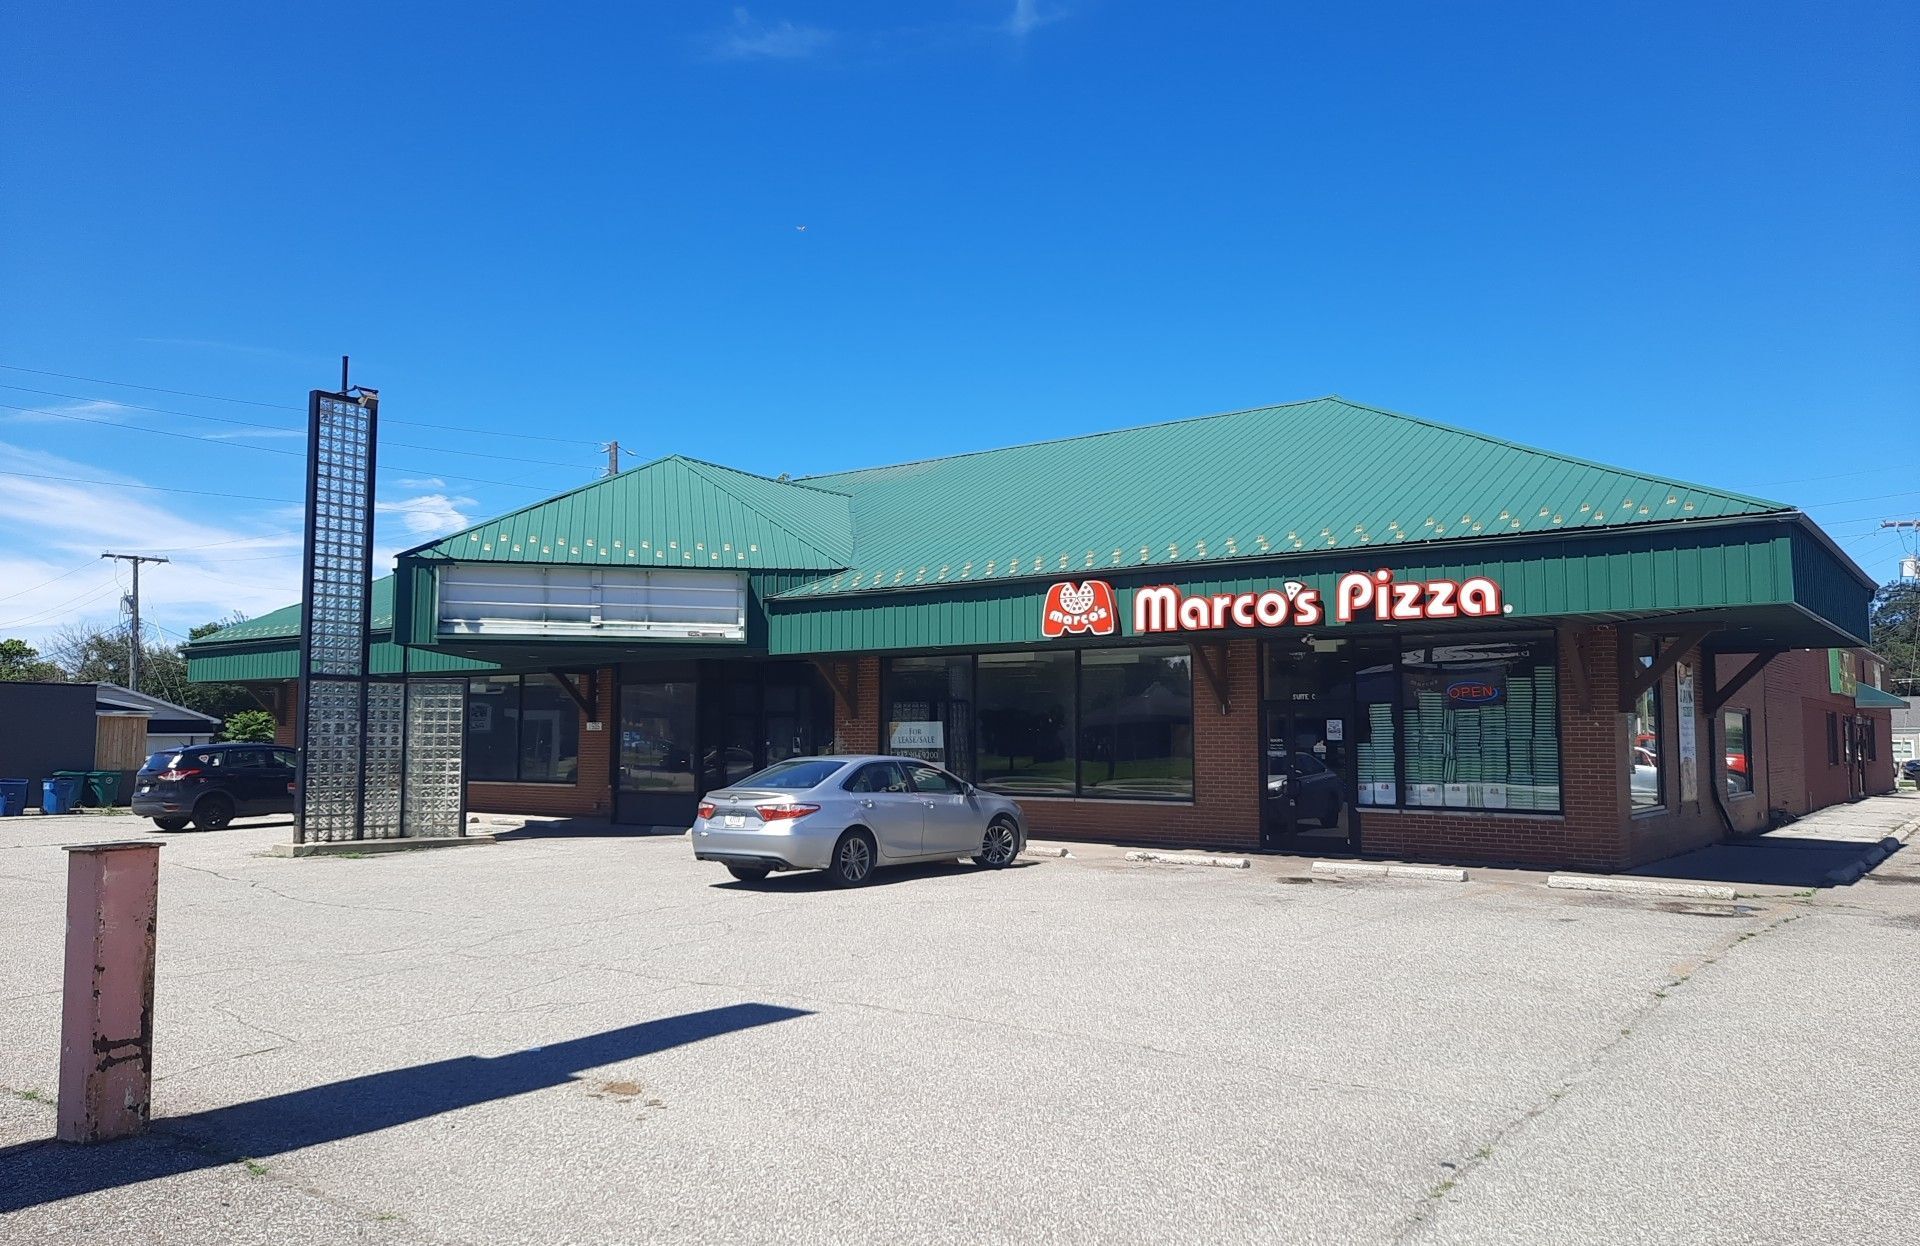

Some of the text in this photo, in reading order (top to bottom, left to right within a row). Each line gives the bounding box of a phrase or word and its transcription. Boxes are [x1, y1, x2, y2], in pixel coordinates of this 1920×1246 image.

[1337, 568, 1501, 622] Pizza
[1449, 686, 1493, 698] OPEN
[898, 735, 936, 744] LEASE/SALE
